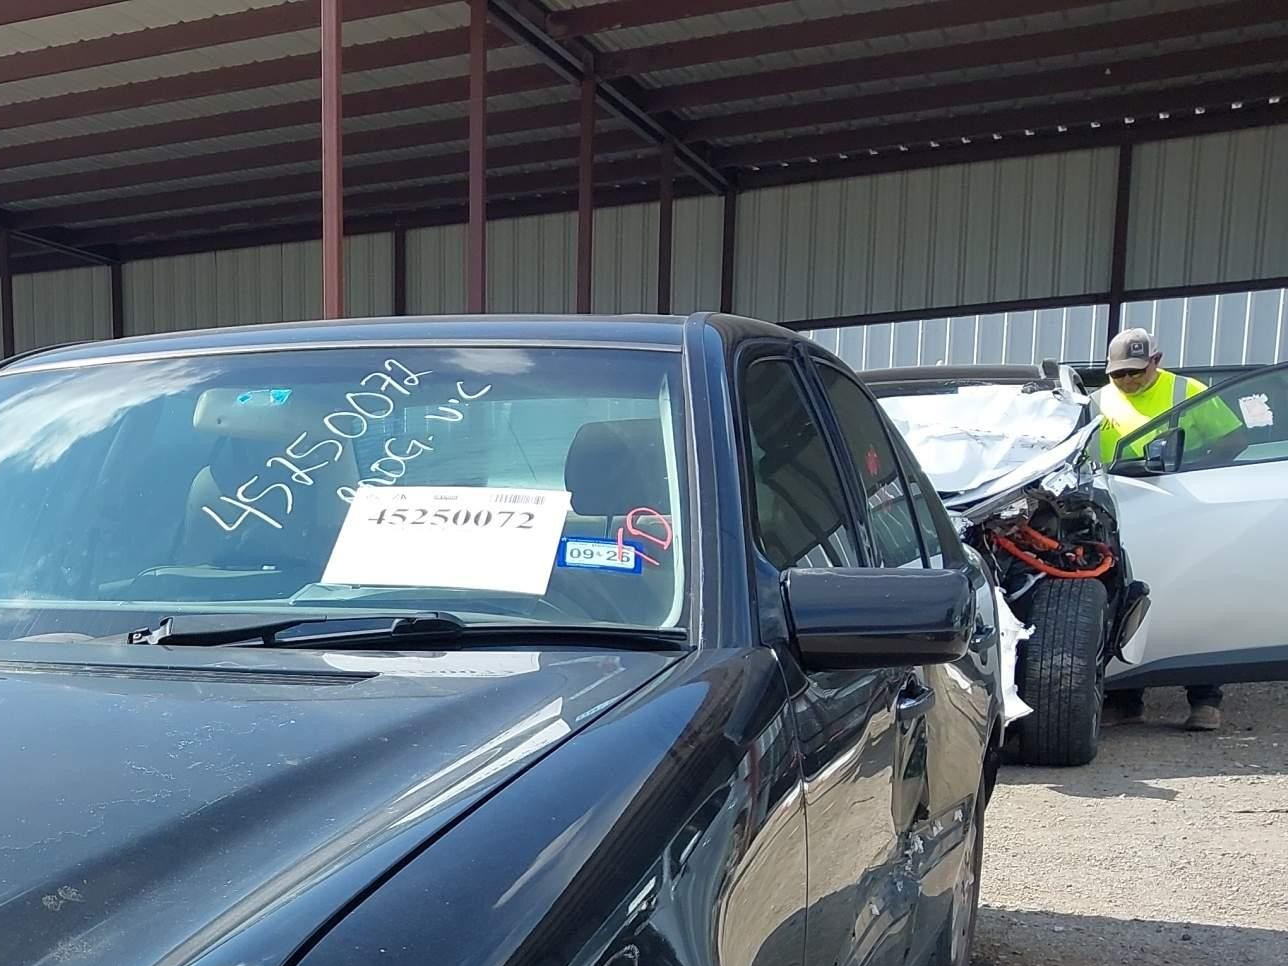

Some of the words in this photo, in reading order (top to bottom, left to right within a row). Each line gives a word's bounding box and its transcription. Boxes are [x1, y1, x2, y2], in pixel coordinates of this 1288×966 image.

[202, 359, 433, 531] 45250072
[367, 507, 536, 530] 45250072
[569, 547, 594, 560] 09
